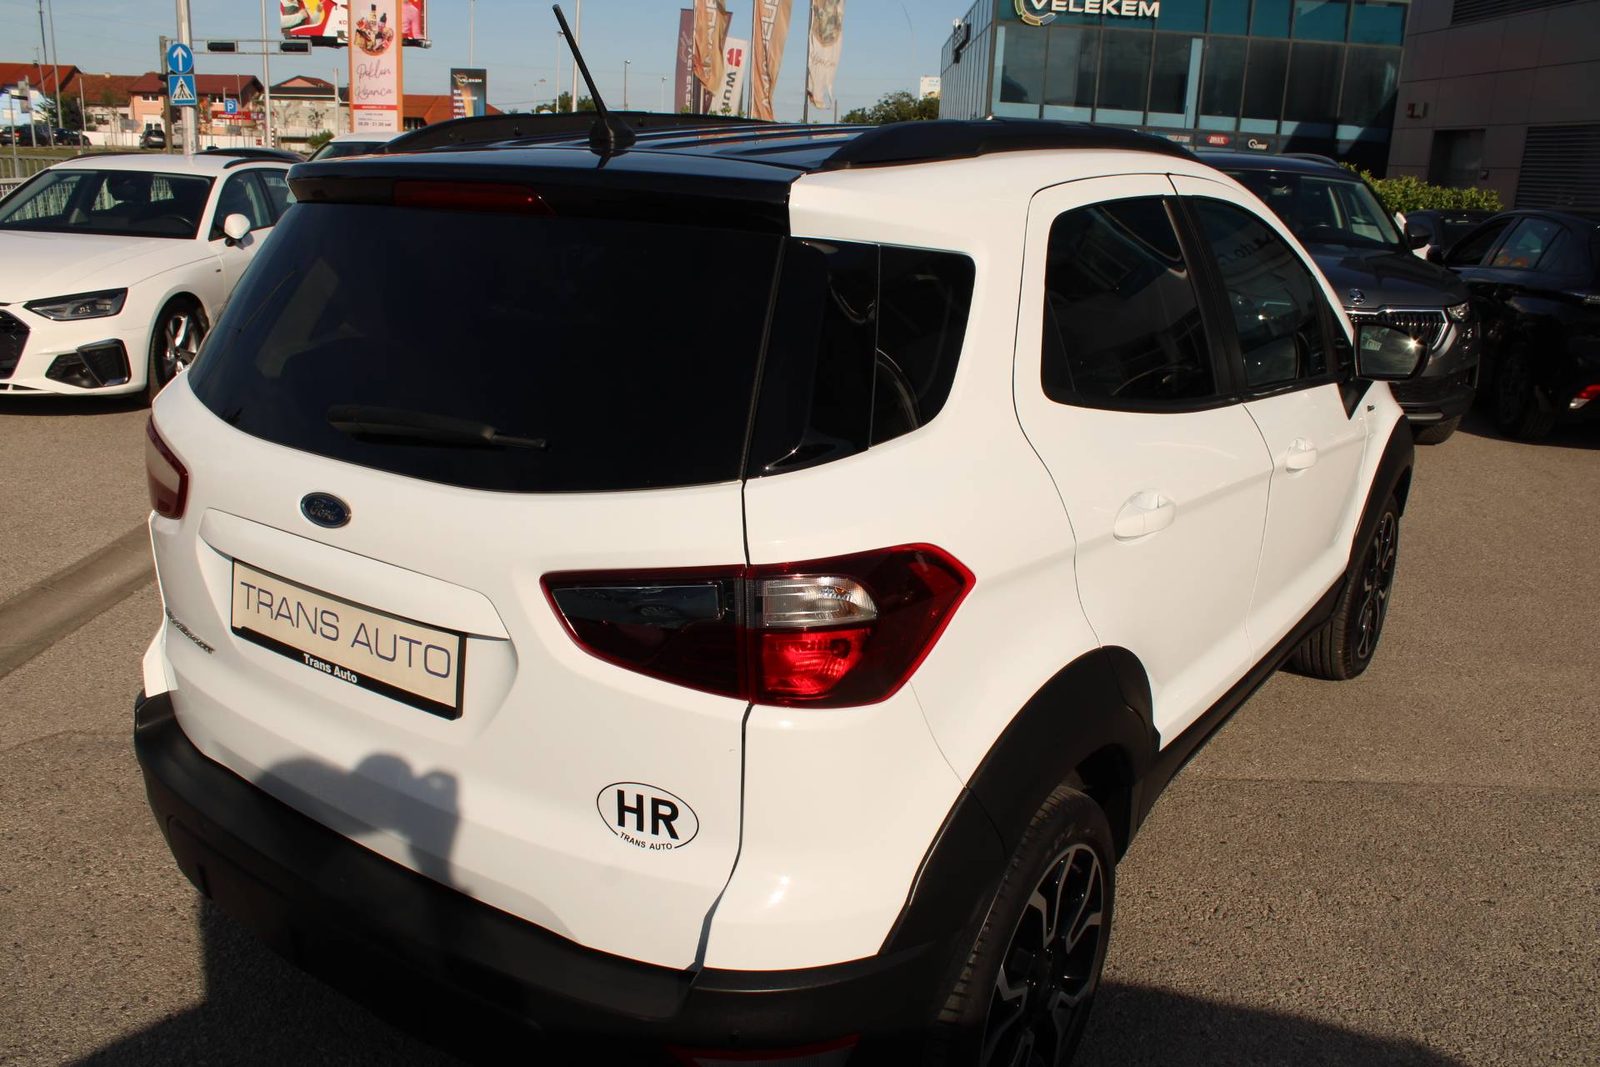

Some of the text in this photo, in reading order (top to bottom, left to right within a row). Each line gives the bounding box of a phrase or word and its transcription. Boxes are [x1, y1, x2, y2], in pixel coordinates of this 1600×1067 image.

[1030, 0, 1160, 18] VELEKEM
[240, 581, 340, 642] TRANS
[351, 623, 451, 679] AUTO
[303, 653, 358, 683] Trans Auto
[617, 789, 679, 840] HR
[620, 832, 672, 850] TRANS AUTO
